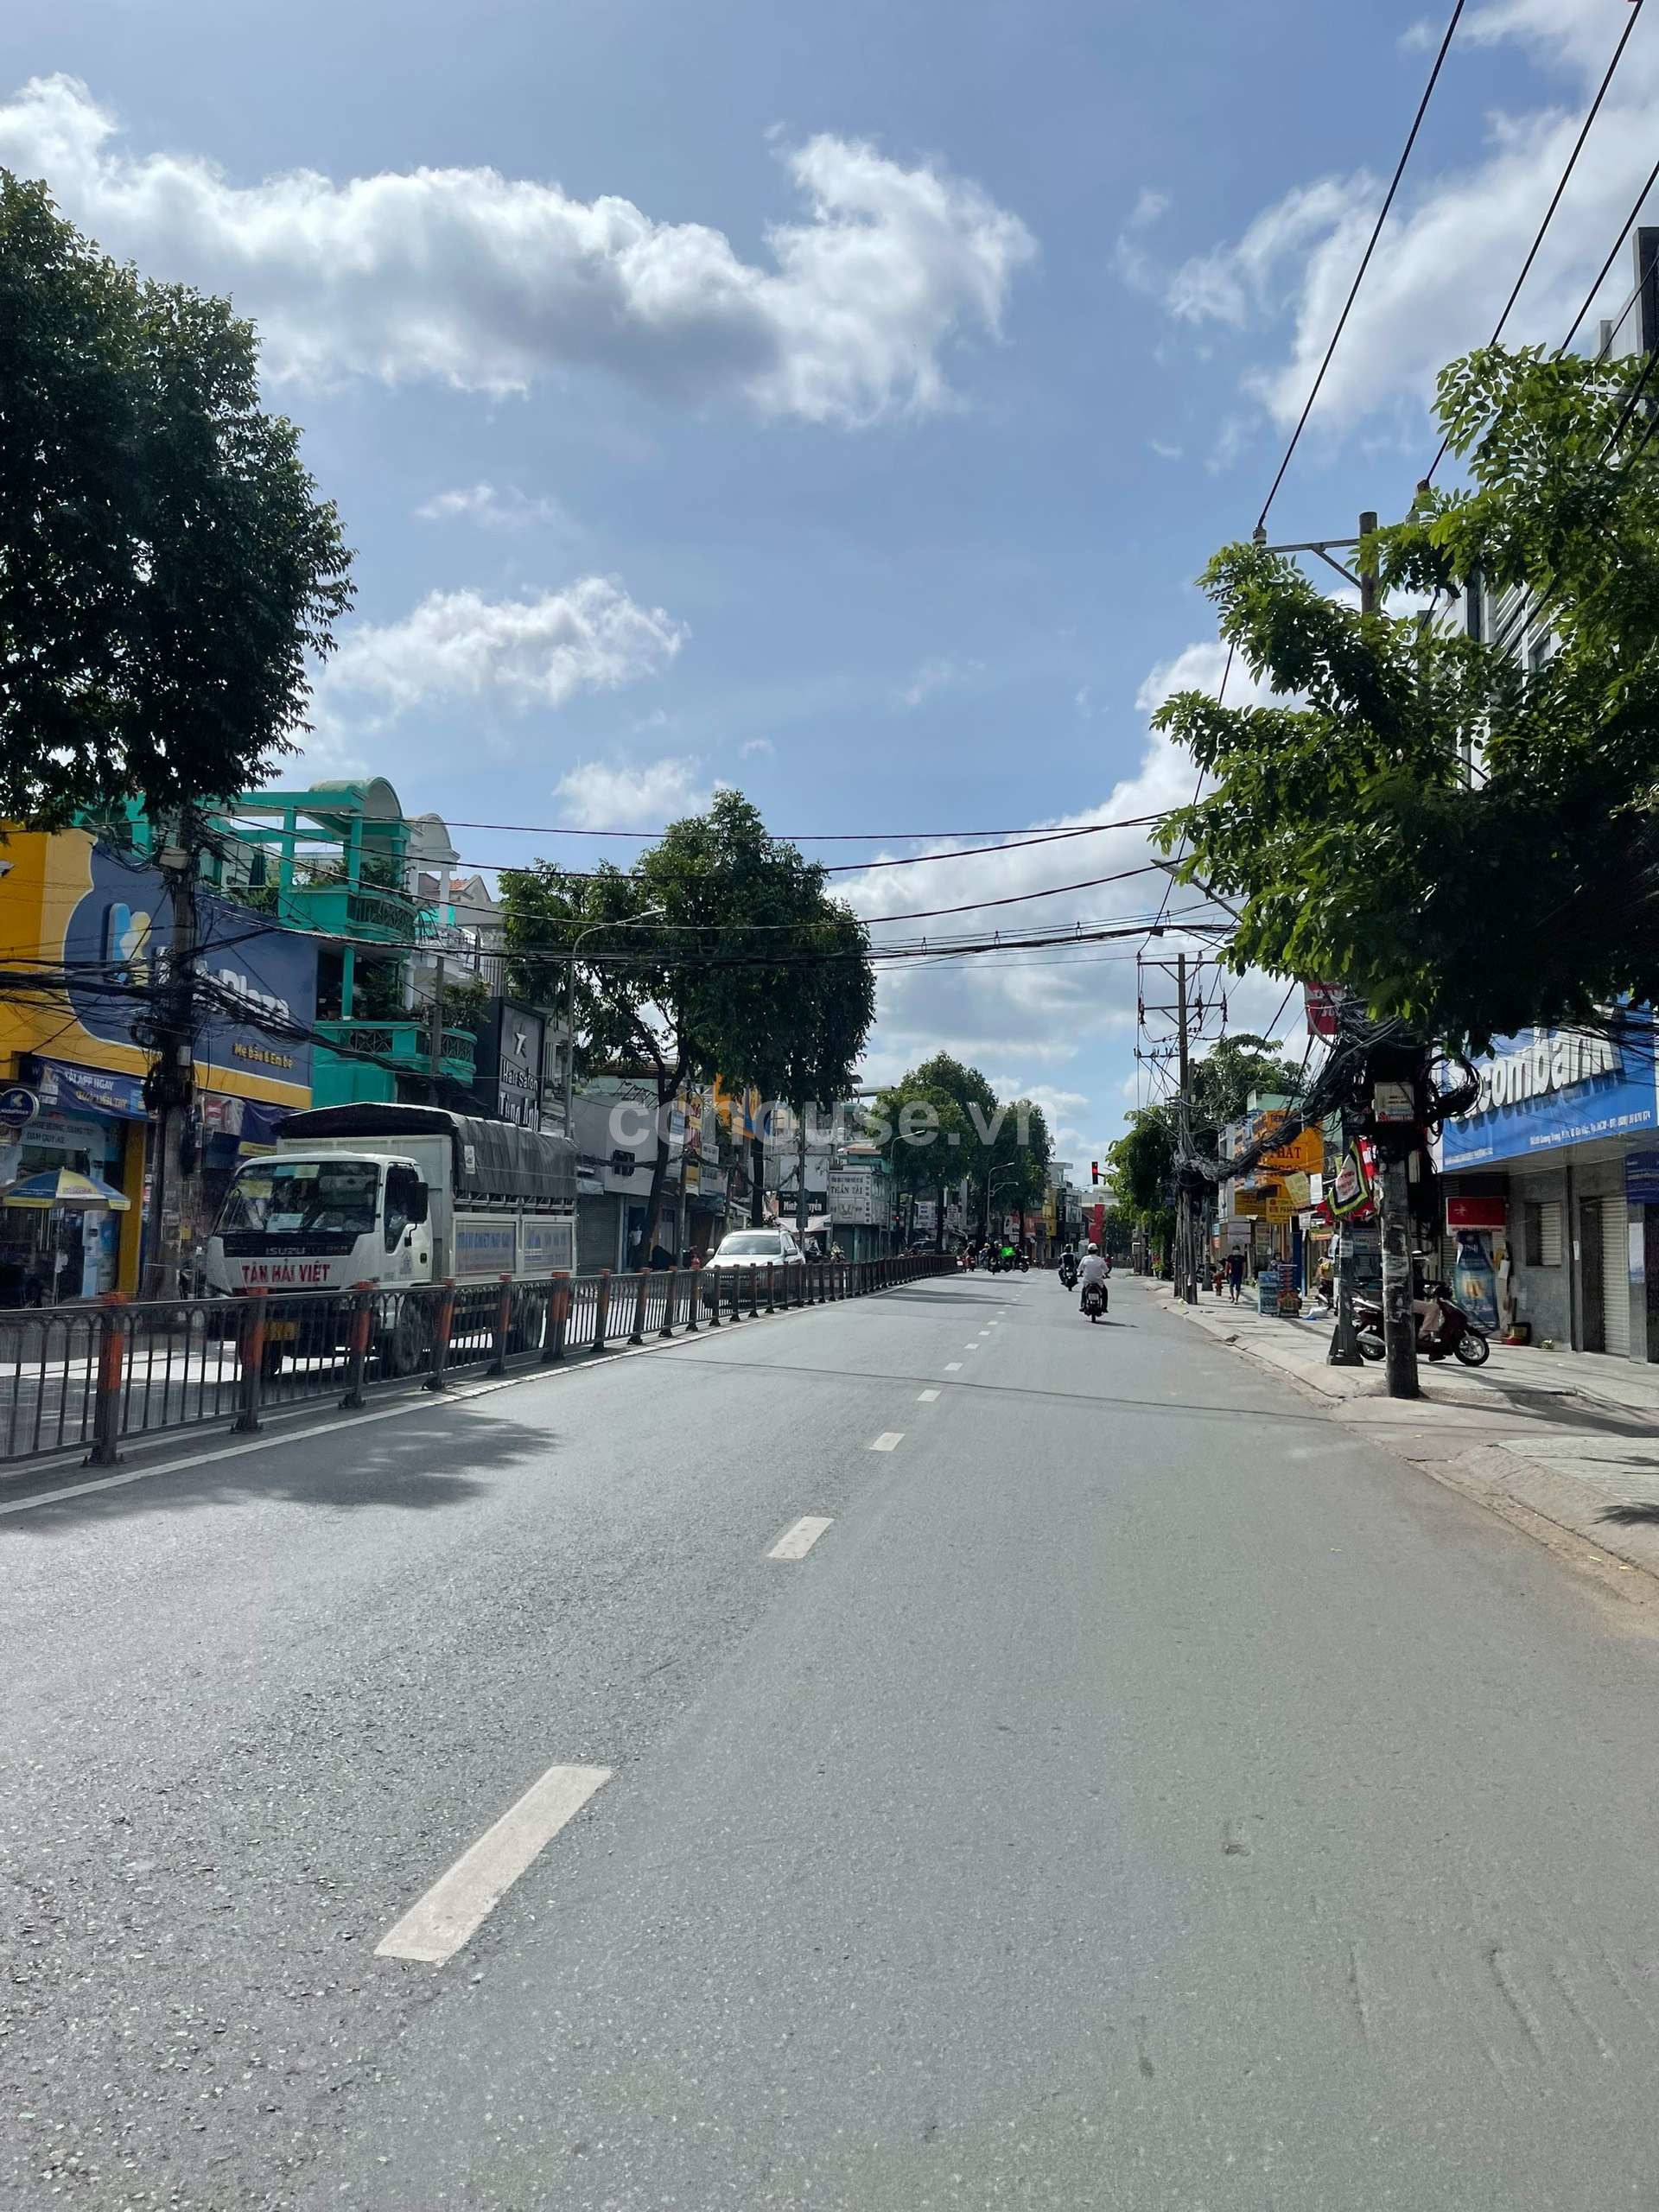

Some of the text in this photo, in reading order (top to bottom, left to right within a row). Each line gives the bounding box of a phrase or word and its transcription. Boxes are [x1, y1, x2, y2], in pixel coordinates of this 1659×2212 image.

[503, 1059, 538, 1091] Hair Salon
[265, 1247, 306, 1255] ISUZU
[242, 1258, 331, 1287] TÂN HẢI VIỆT
